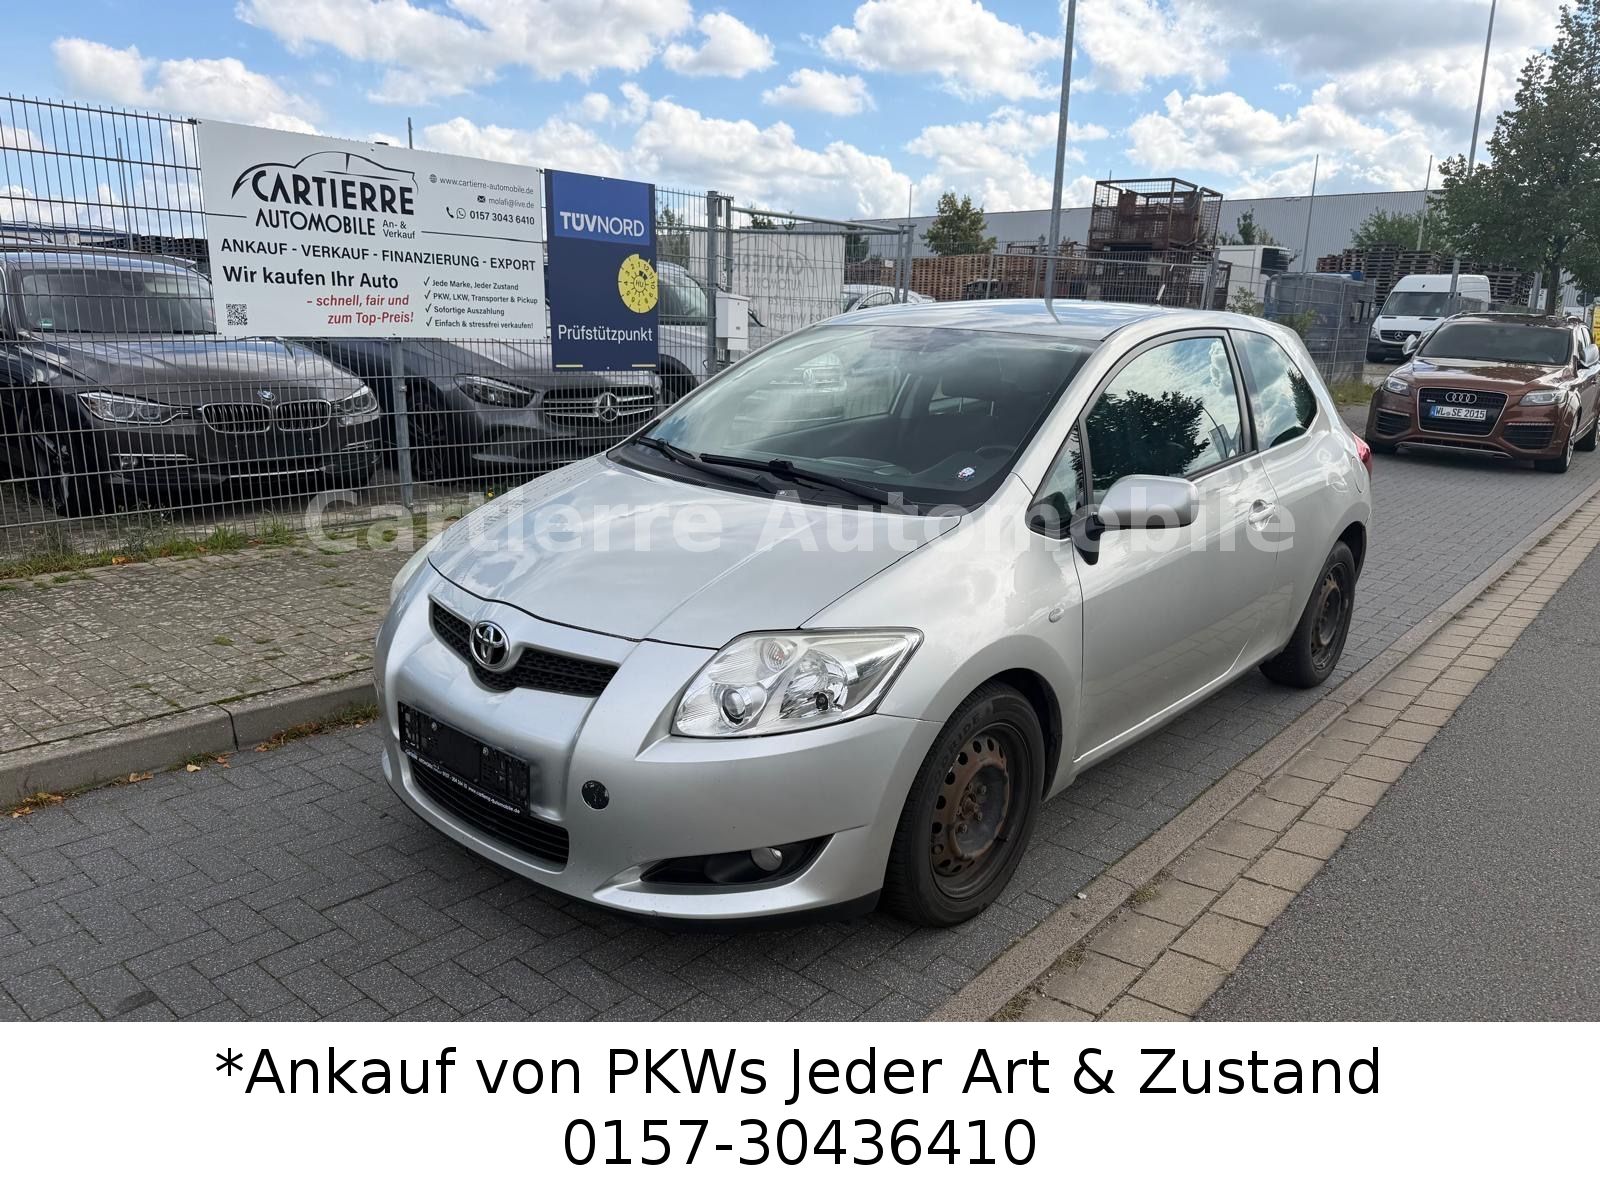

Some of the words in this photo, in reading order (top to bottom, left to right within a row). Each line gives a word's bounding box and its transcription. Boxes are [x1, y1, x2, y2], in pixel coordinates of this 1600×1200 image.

[252, 170, 414, 215] CARTIERRE
[439, 177, 534, 195] www.cartierre-automobile.de
[255, 208, 376, 236] AUTOMOBILE
[382, 219, 398, 229] An-
[400, 220, 407, 230] &
[469, 210, 490, 221] 0157
[492, 213, 514, 223] 3043
[515, 216, 535, 225] 6410
[382, 229, 416, 240] Verkauf
[221, 238, 288, 255] ANKAUF
[301, 244, 369, 260] VERKAUF
[382, 250, 479, 268] FINANZIERUNG
[490, 257, 536, 271] EXPORT
[223, 265, 257, 283] Wir
[262, 267, 326, 286] kaufen
[331, 271, 354, 287] Ihr
[360, 273, 399, 289] Auto
[449, 281, 473, 289] Marke,
[316, 294, 362, 307] schnell,
[366, 294, 386, 306] fair
[388, 294, 410, 306] und
[433, 293, 452, 301] PKW,
[453, 294, 470, 302] LKW,
[472, 295, 509, 303] Transporter
[517, 296, 538, 304] Pickup
[328, 314, 352, 324] zum
[355, 311, 414, 326] Top-Preis!
[434, 306, 465, 315] Sofortige
[467, 307, 505, 316] Auszahlung
[558, 324, 653, 344] Prüfstützpunkt
[1451, 408, 1462, 417] SE
[1464, 409, 1485, 419] 2015
